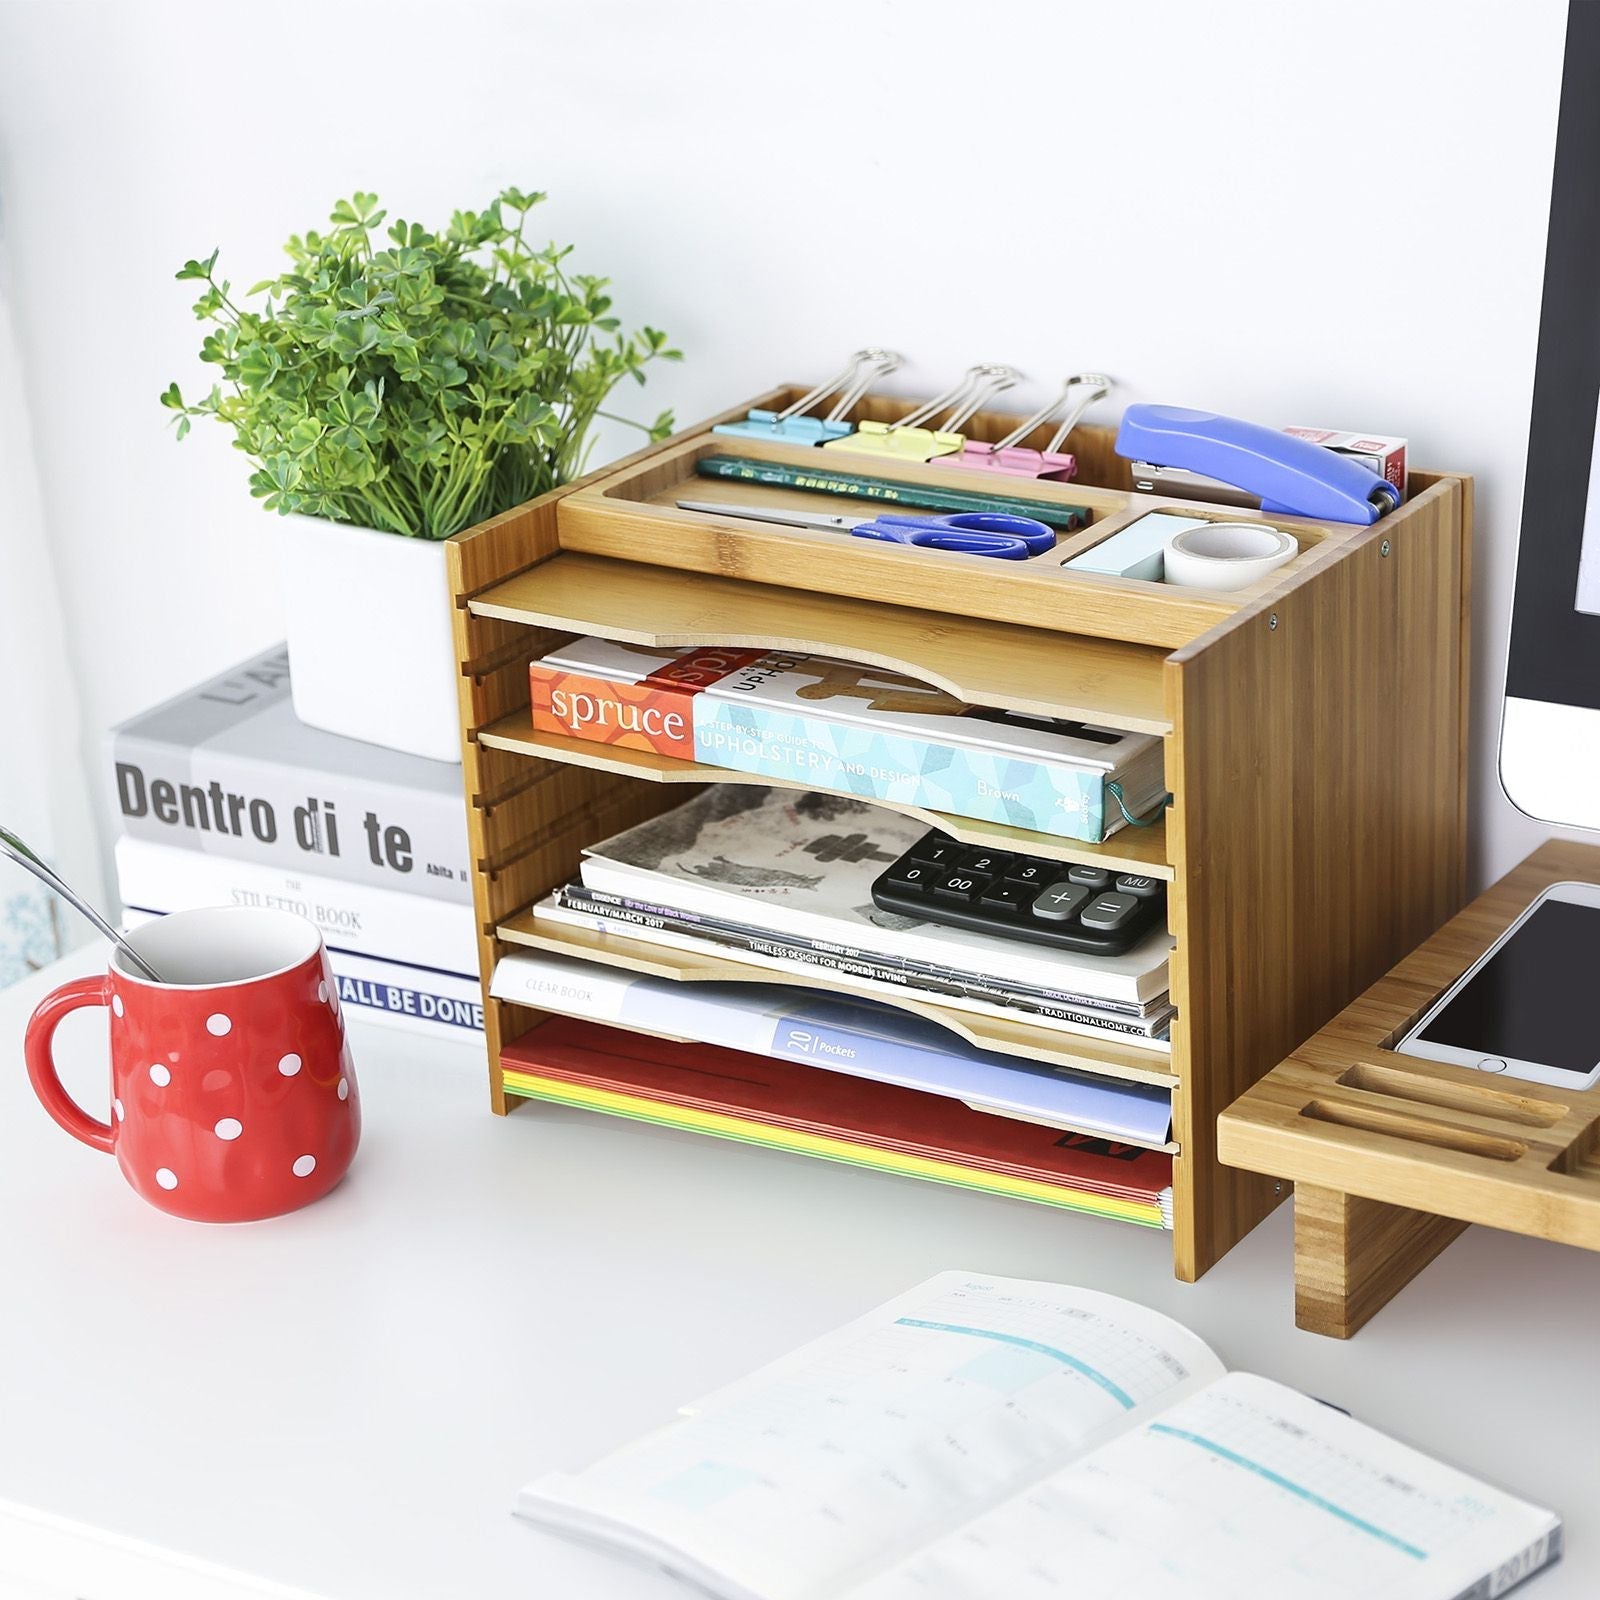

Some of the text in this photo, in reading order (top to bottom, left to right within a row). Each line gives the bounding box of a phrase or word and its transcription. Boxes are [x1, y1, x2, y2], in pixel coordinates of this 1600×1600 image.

[550, 689, 685, 740] spruce
[776, 734, 809, 747] GUIDE
[811, 739, 826, 750] TO
[700, 731, 922, 787] UPHOLSTERY AND DESIGN
[976, 780, 1020, 803] Brown
[115, 763, 277, 843] Dentro
[294, 797, 340, 857] di
[364, 812, 414, 873] te
[426, 863, 454, 880] Abita
[906, 869, 920, 880] 0
[947, 877, 973, 891] 00
[932, 849, 945, 860] 1
[974, 858, 991, 869] 2
[1022, 867, 1037, 879] 3
[1124, 876, 1150, 888] MU
[315, 905, 362, 930] BOOK
[567, 899, 643, 924] FEBRUARY/MARCH
[644, 917, 665, 929] 2017
[749, 939, 908, 985] TIMELESS DESIGN FOR MODERN LIVING
[811, 939, 860, 958] FEBRUARY 2017
[526, 977, 593, 1002] CLEAR BOOK
[387, 987, 416, 1014] BE
[419, 994, 485, 1029] DONE
[787, 1030, 857, 1059] 20 Pockets
